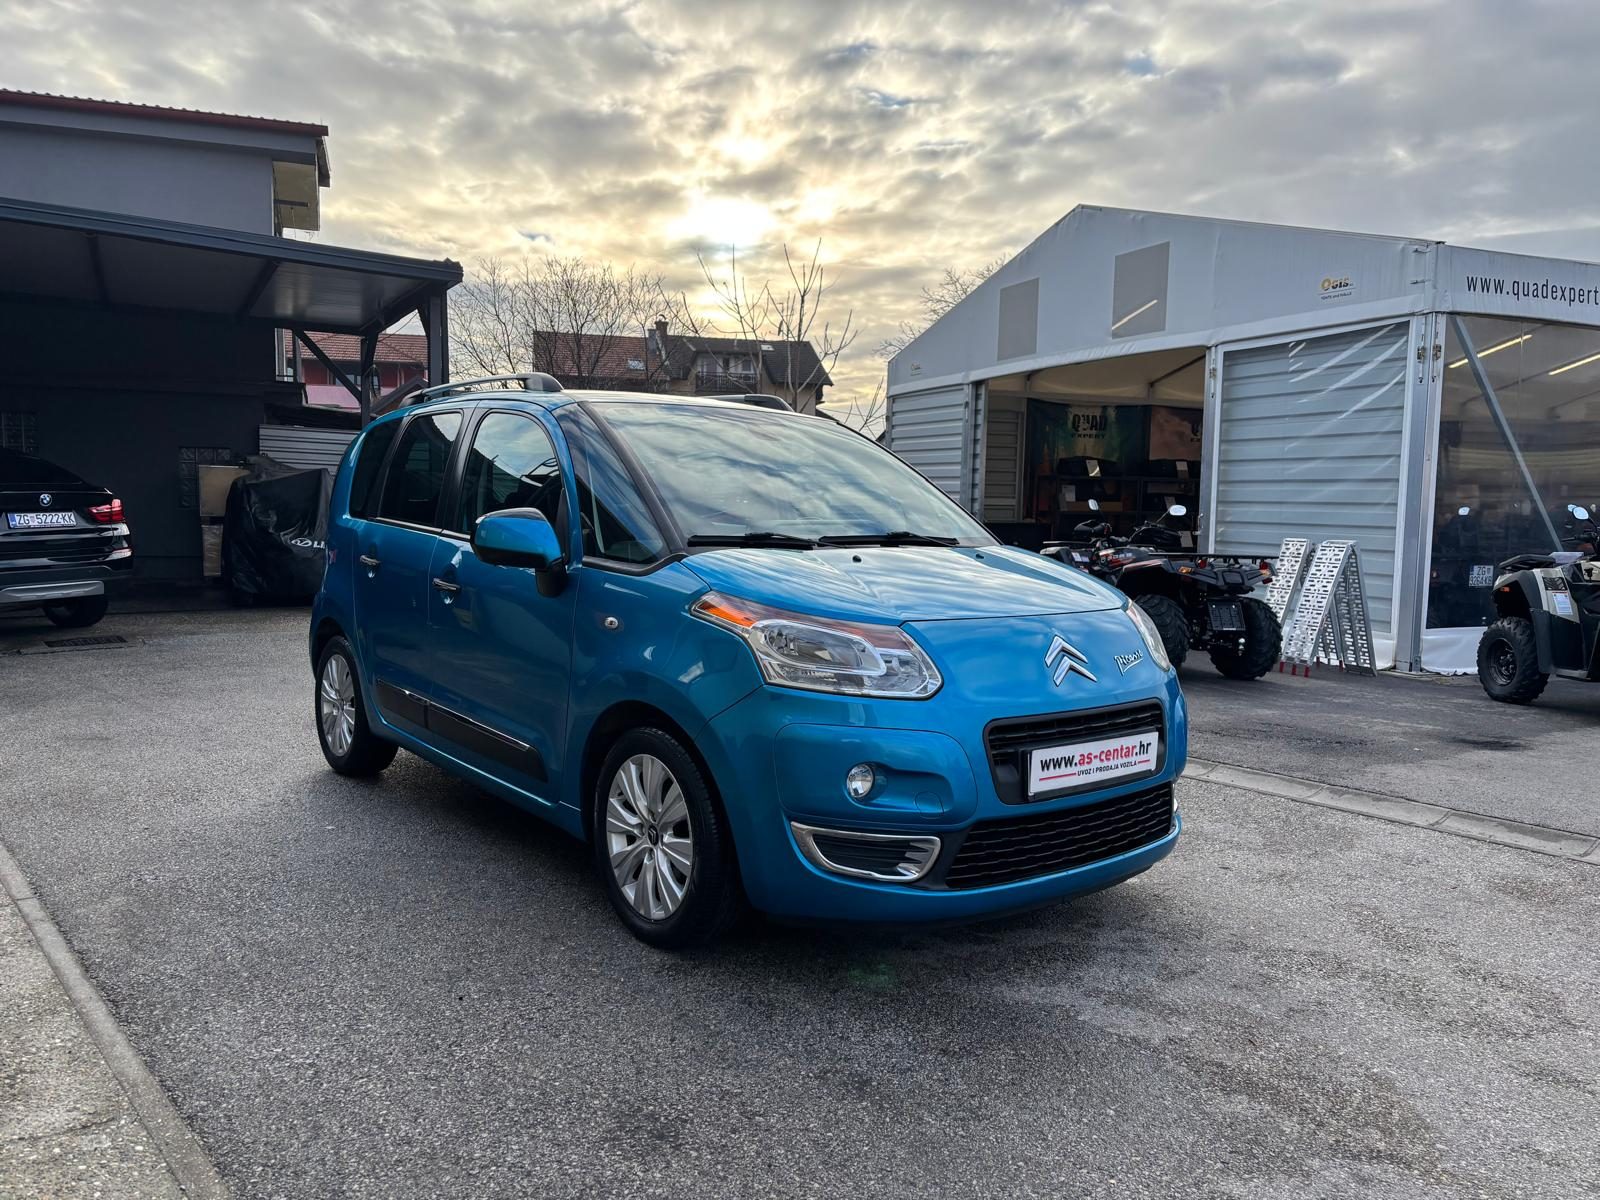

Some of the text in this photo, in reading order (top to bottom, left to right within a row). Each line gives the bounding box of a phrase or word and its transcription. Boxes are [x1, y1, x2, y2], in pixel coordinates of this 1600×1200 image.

[1466, 274, 1599, 307] www.quadexpert
[1072, 414, 1107, 432] QUAD
[16, 514, 30, 525] ZG
[1477, 566, 1486, 576] ZG
[1040, 740, 1152, 773] www.as-centar.hr
[1077, 767, 1092, 776] UVOZ
[1095, 764, 1119, 774] PRODAJA
[1119, 760, 1137, 769] VOZILA
